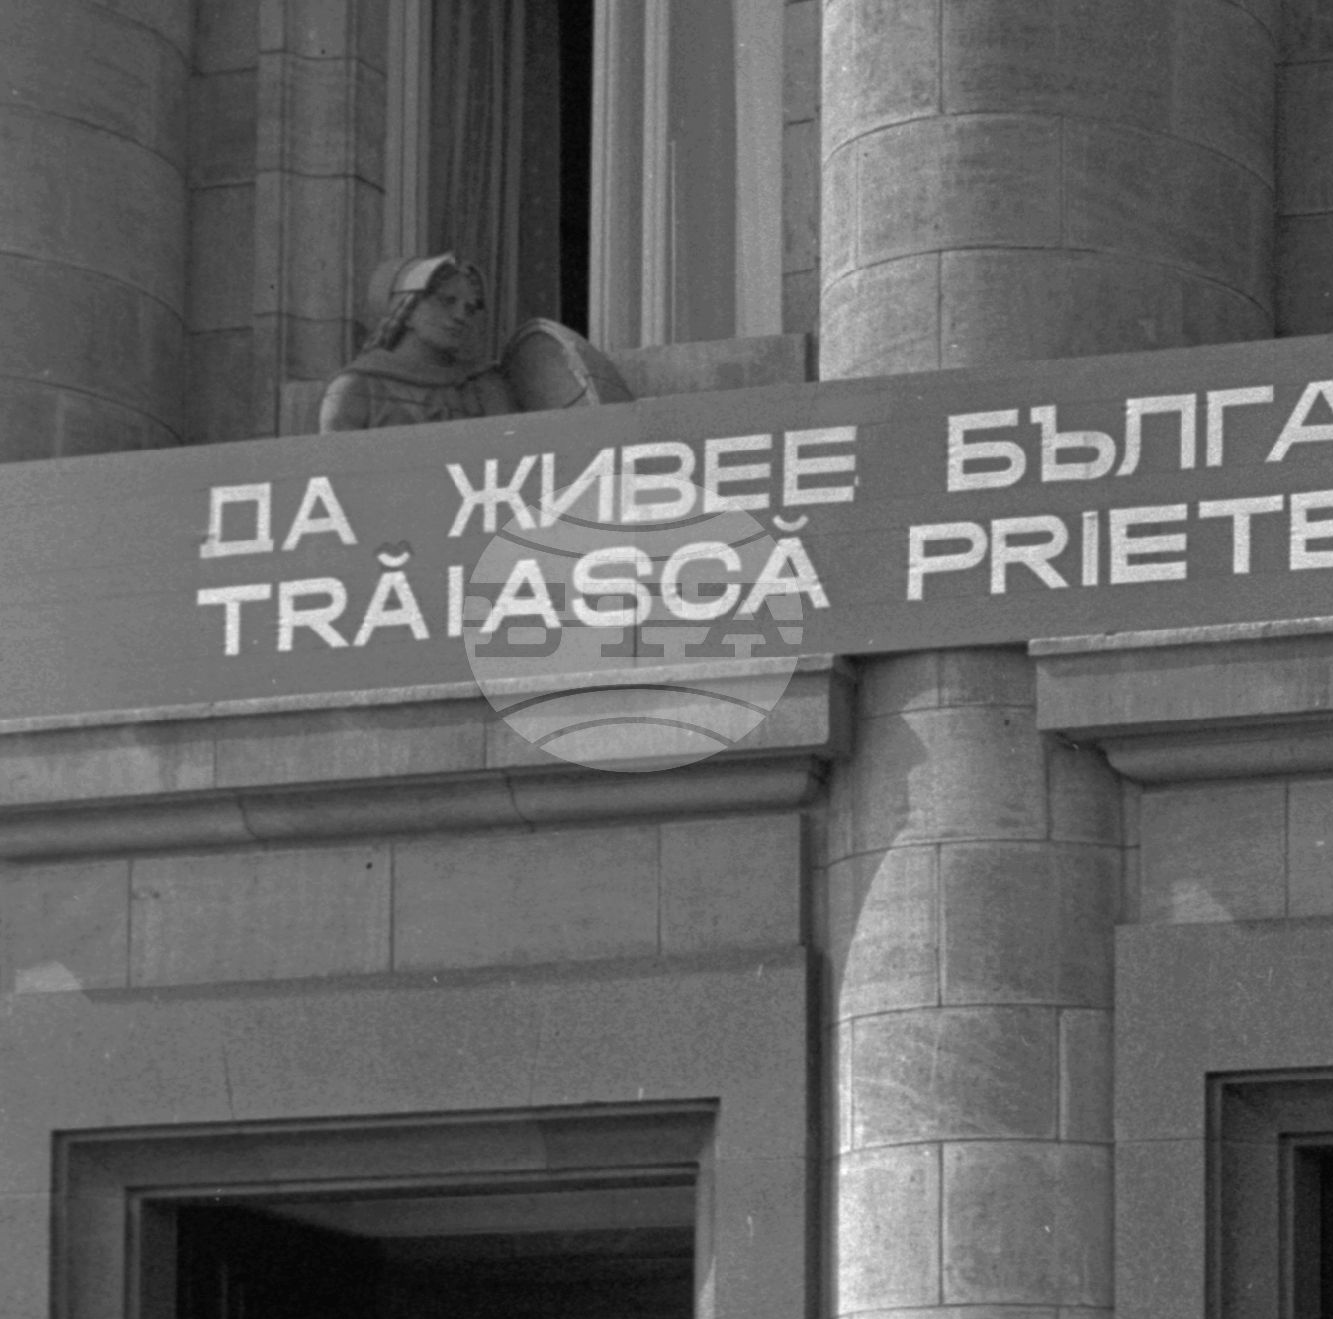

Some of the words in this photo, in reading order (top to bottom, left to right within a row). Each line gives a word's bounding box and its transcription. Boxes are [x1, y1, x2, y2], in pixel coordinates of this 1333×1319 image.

[201, 476, 358, 559] ДА
[446, 426, 858, 537] ЖИВЕЕ
[197, 514, 831, 656] TRĂIASCĂ
